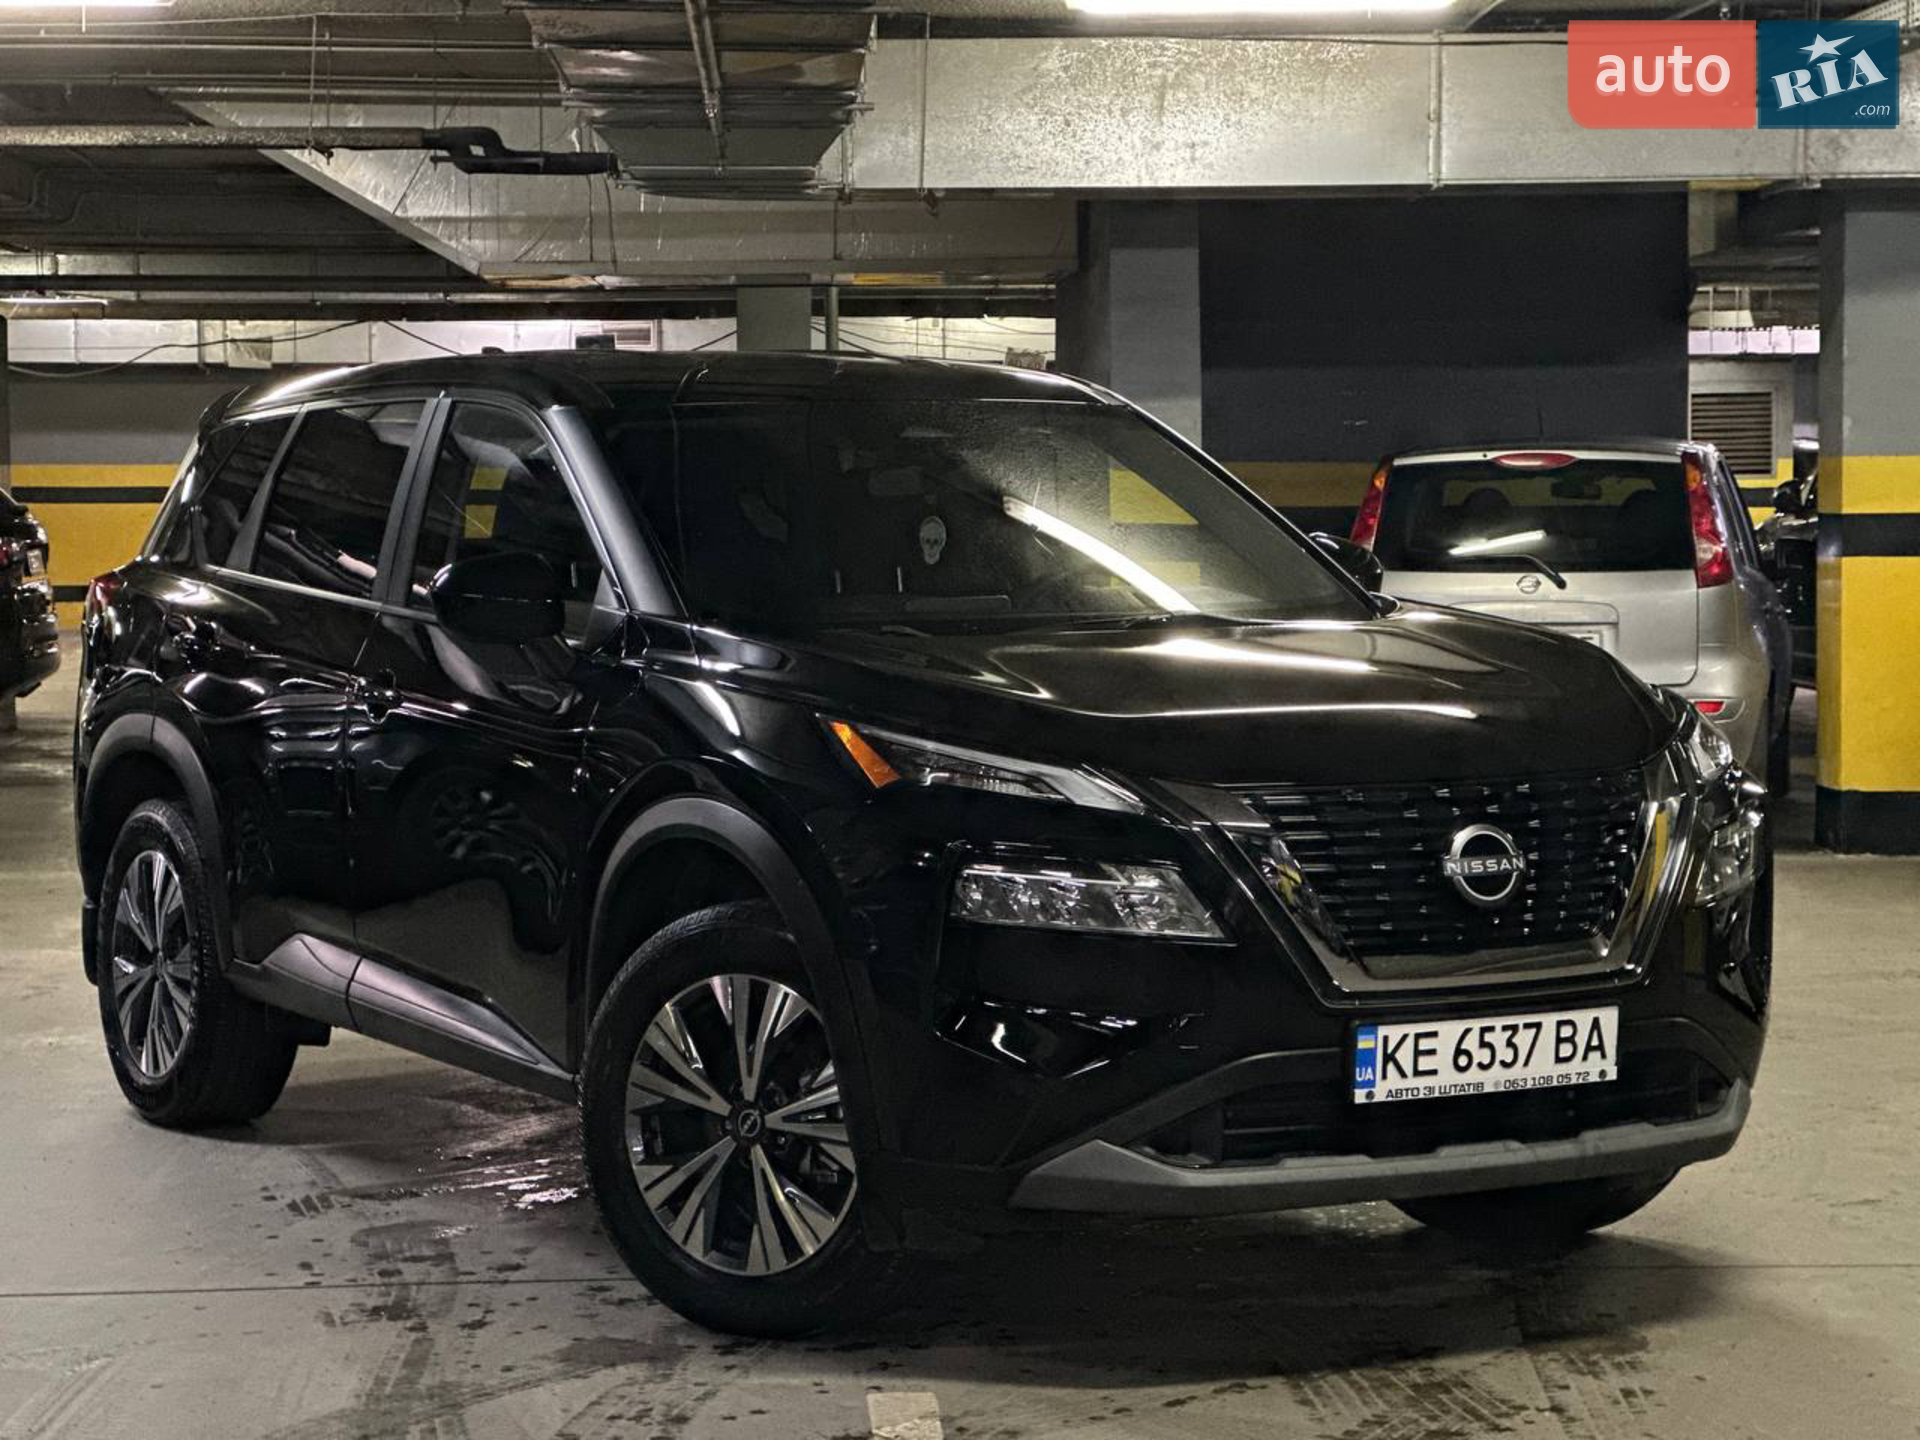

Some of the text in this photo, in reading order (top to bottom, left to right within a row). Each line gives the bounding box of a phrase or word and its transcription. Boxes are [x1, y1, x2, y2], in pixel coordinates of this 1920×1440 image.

[1446, 857, 1524, 874] NISSAN
[1381, 1016, 1607, 1080] KE 6537 BA
[1356, 1067, 1374, 1080] UA
[1504, 1071, 1590, 1090] 063 108 05 72
[1386, 1087, 1420, 1099] АВТО
[1439, 1082, 1485, 1095] ШТАТІВ
